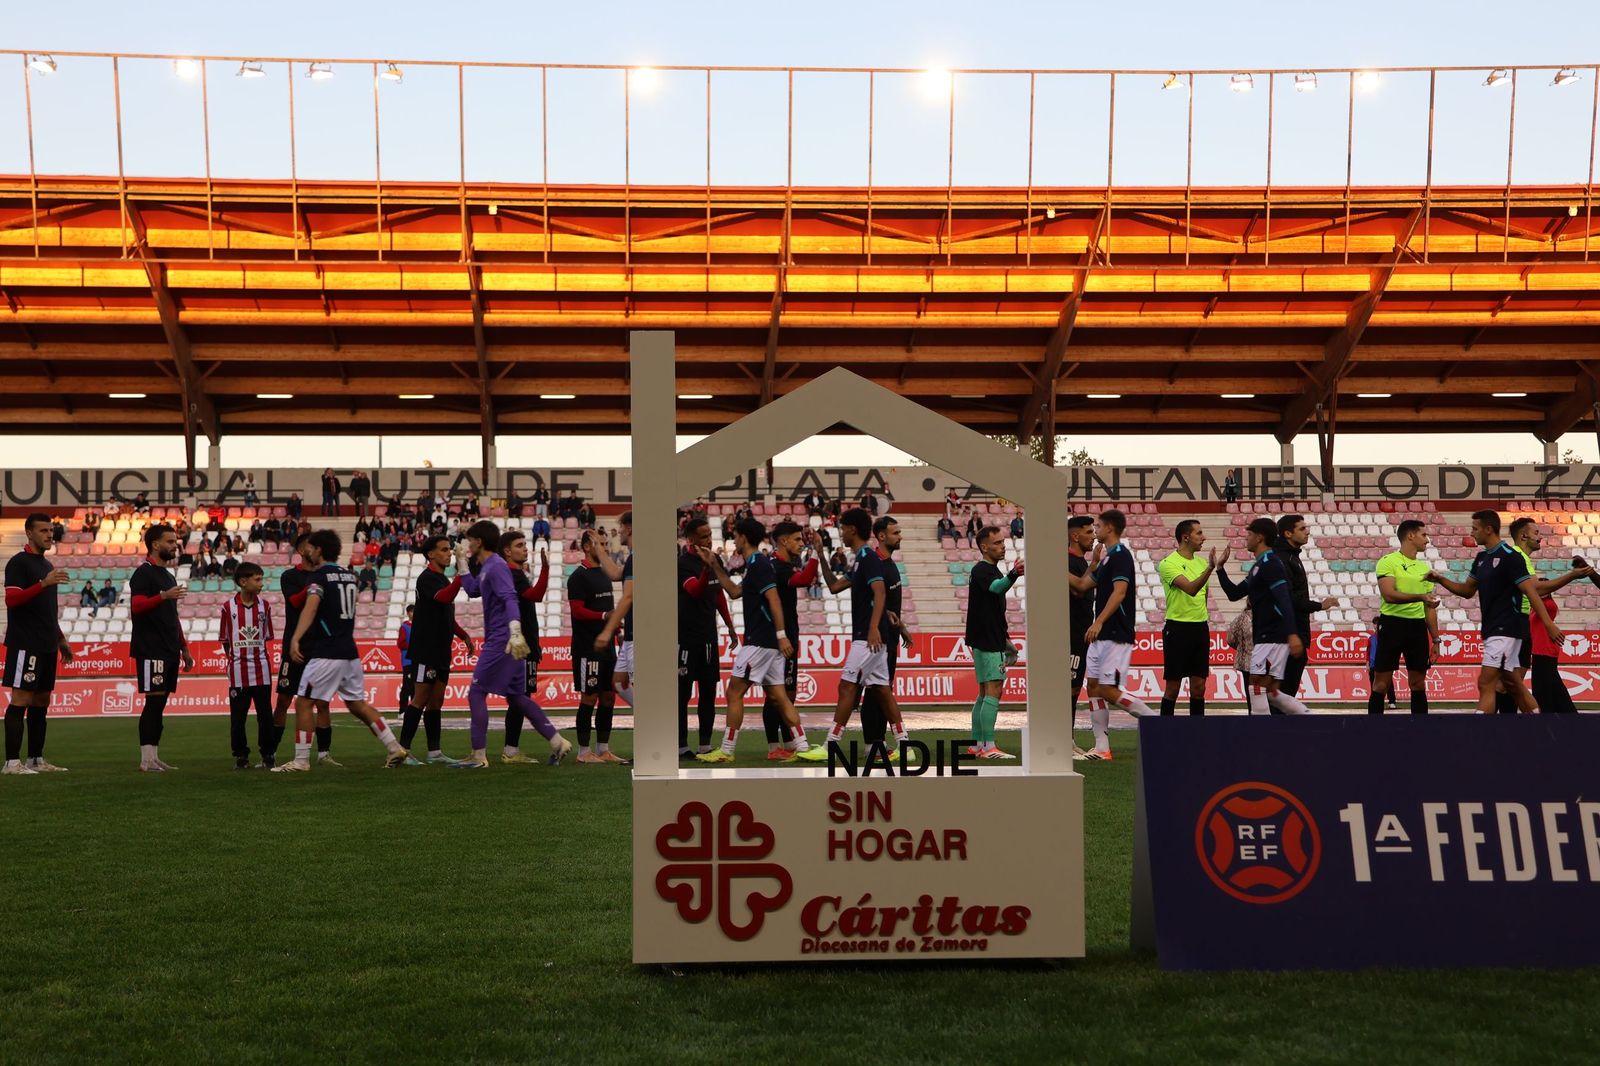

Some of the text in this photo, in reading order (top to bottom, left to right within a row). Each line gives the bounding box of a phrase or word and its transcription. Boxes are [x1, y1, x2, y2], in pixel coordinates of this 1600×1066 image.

[507, 470, 583, 500] DE
[1438, 466, 1515, 499] DE
[337, 583, 357, 620] 10
[28, 655, 37, 671] 9
[64, 658, 123, 671] sangregorio
[587, 661, 599, 675] 14
[892, 674, 953, 696] RACIÓN
[105, 695, 130, 708] Susi
[827, 739, 979, 777] NADIE
[828, 790, 893, 823] SIN
[828, 828, 968, 861] HOGAR
[800, 893, 1032, 937] Cáritas
[801, 936, 988, 954] Diocesana de Zamora
